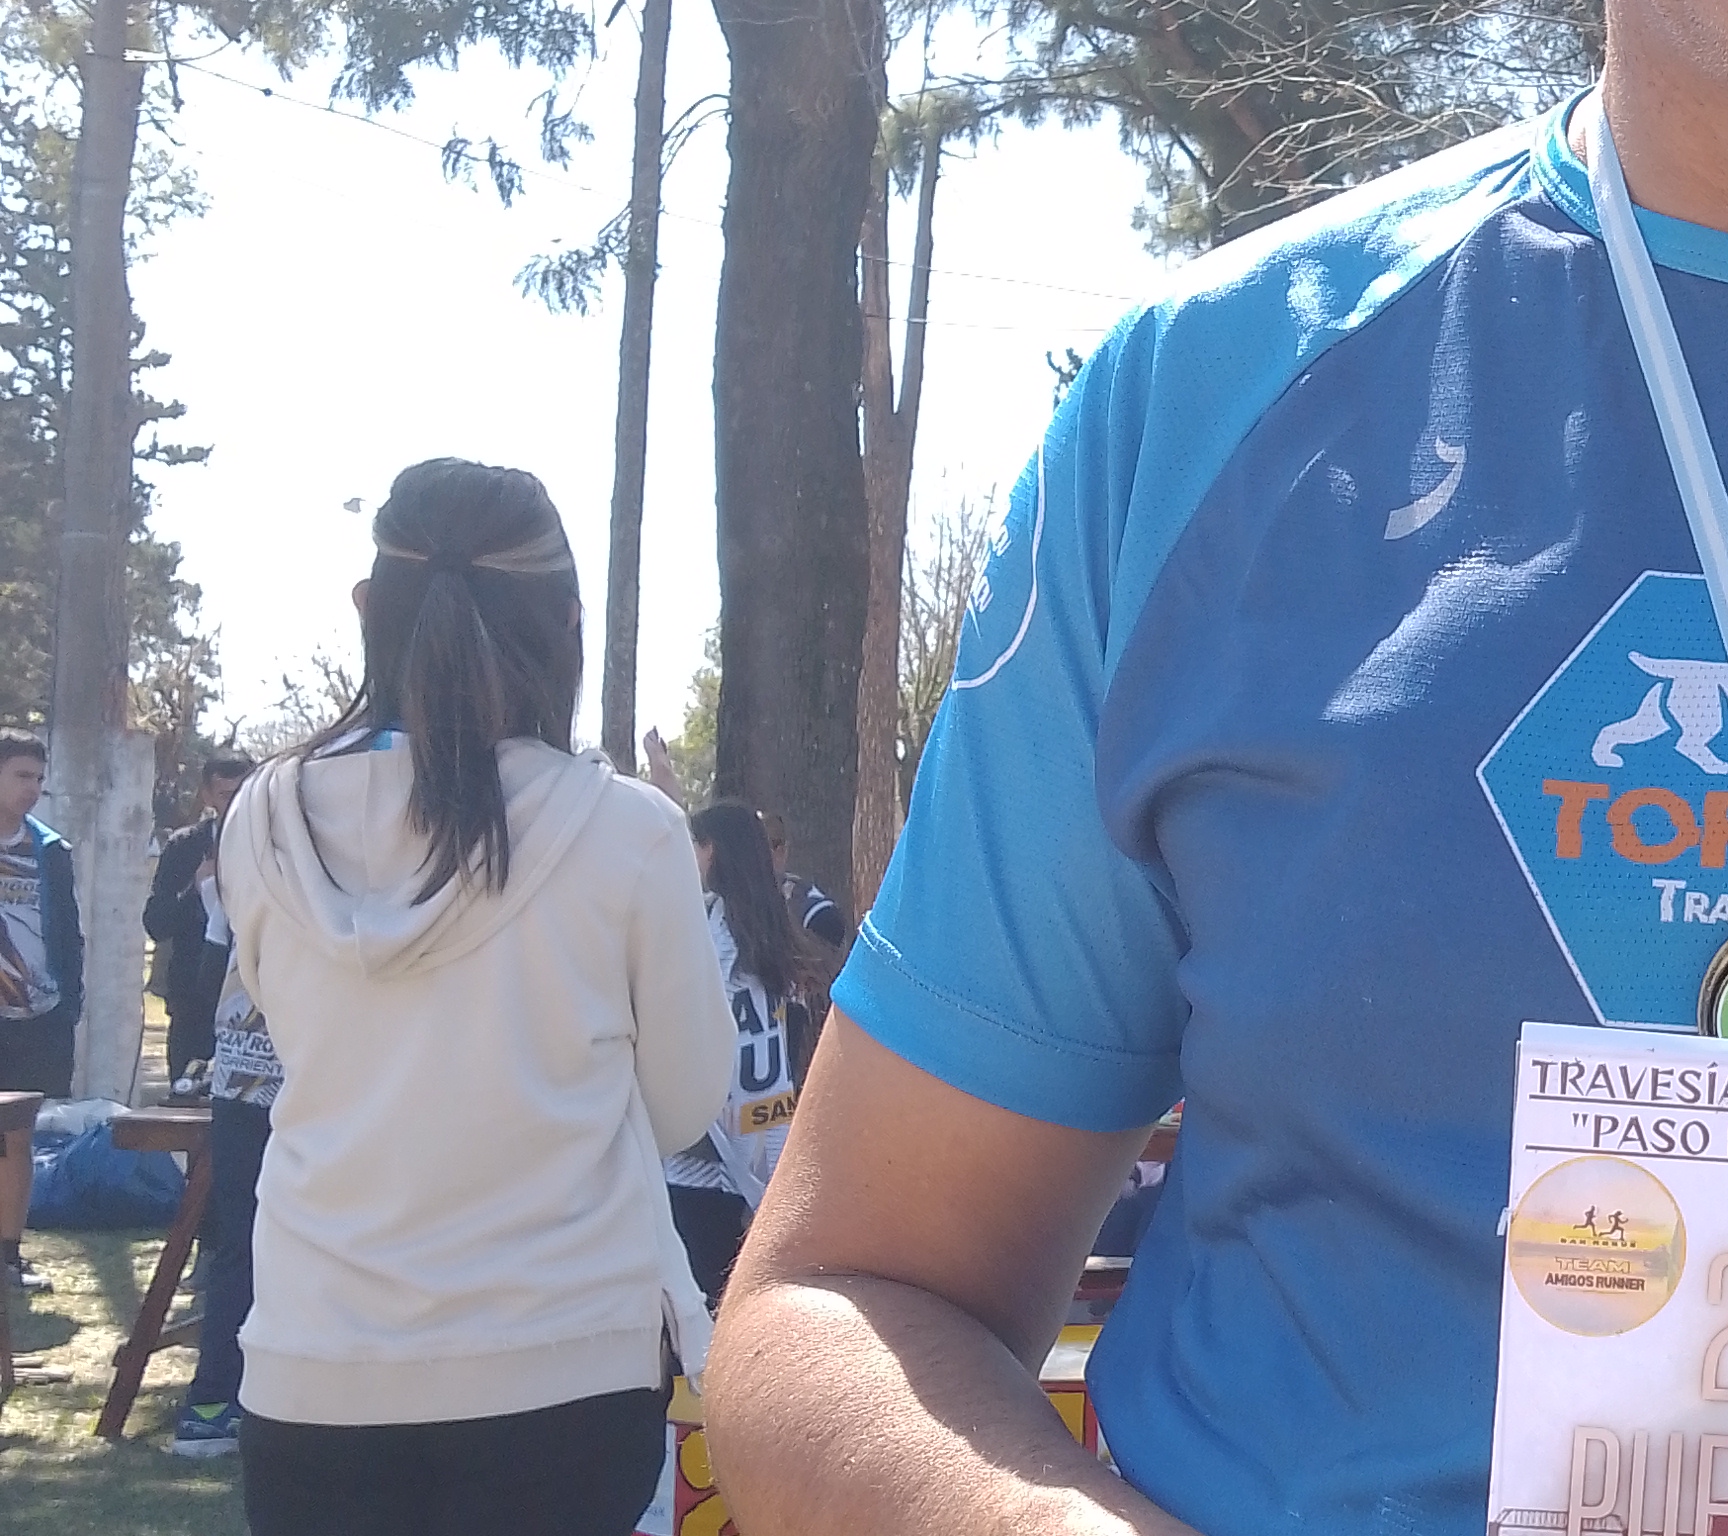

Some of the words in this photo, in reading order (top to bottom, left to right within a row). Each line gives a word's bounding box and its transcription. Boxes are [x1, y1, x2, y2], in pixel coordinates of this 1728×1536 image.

[1571, 1112, 1711, 1157] "PASO
[1556, 1257, 1631, 1274] TEAM
[1545, 1273, 1594, 1288] AMIGOS
[1596, 1276, 1645, 1291] RUNNER
